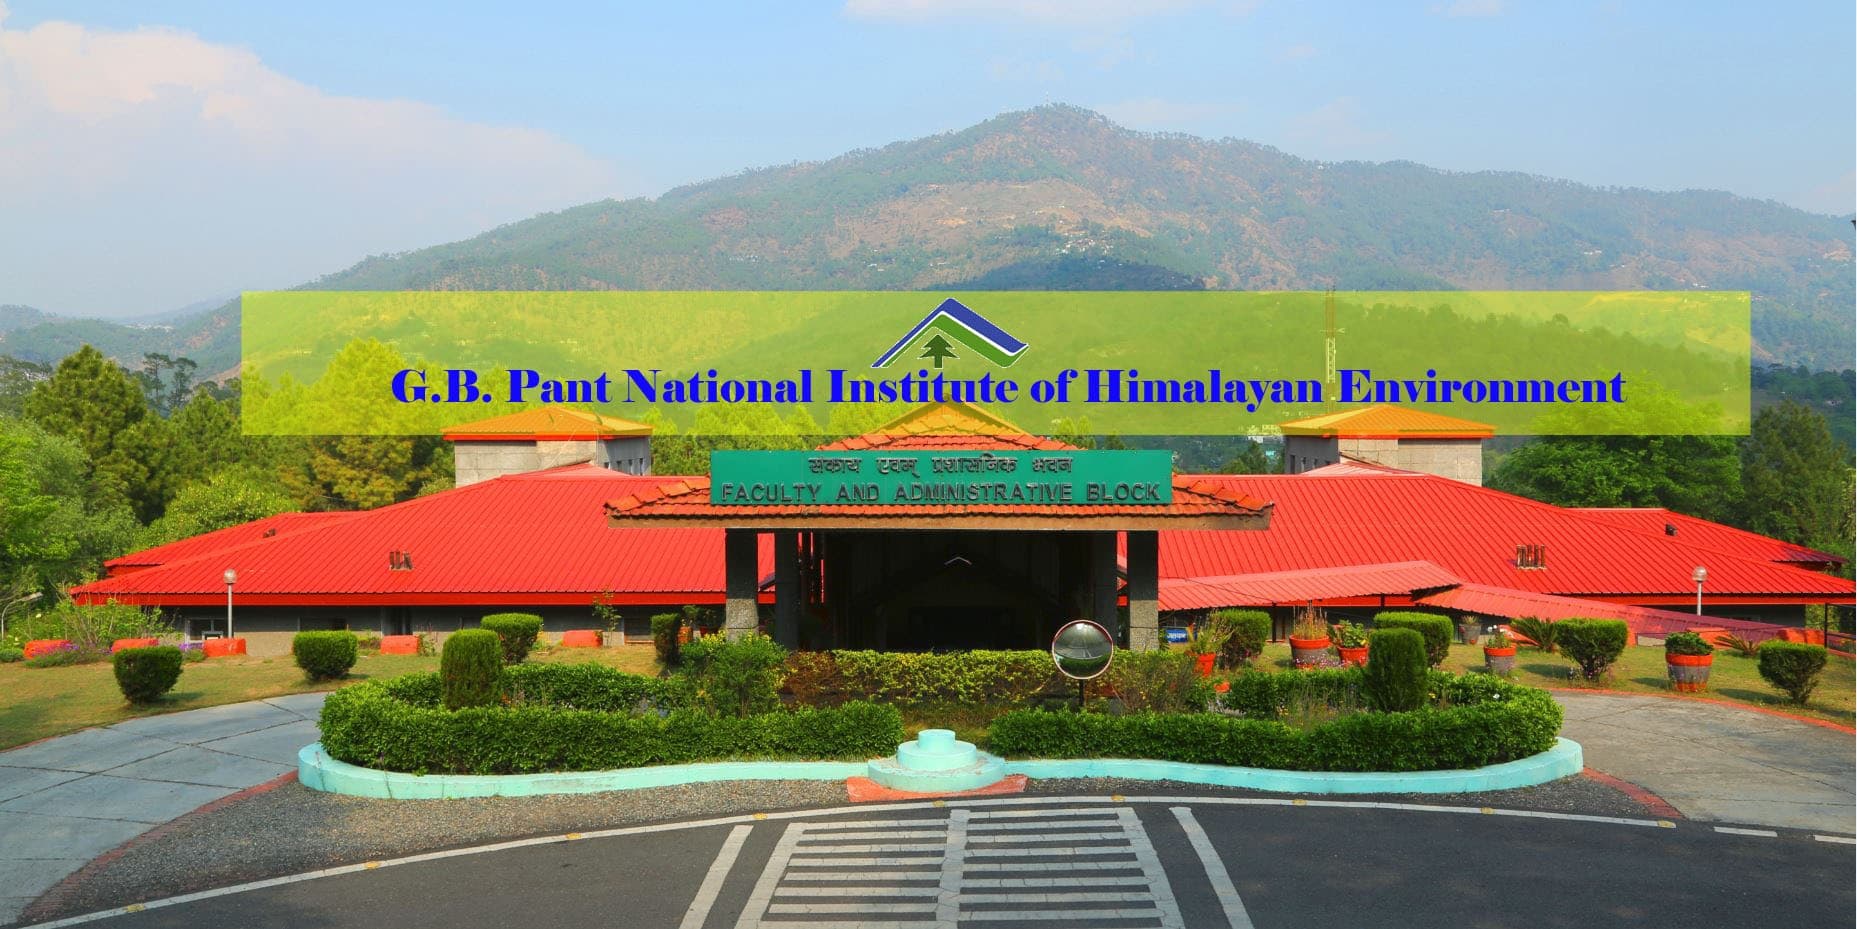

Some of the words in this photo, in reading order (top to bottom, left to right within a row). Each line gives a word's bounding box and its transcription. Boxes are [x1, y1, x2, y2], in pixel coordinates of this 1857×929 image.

[876, 457, 920, 478] एवम्
[931, 452, 1018, 473] प्रशासनिक
[1032, 457, 1073, 473] भवन
[721, 482, 821, 501] FACULTY
[836, 483, 880, 501] AND
[894, 482, 1073, 501] ADMINISTRATIVE
[1087, 482, 1161, 501] BLOCK
